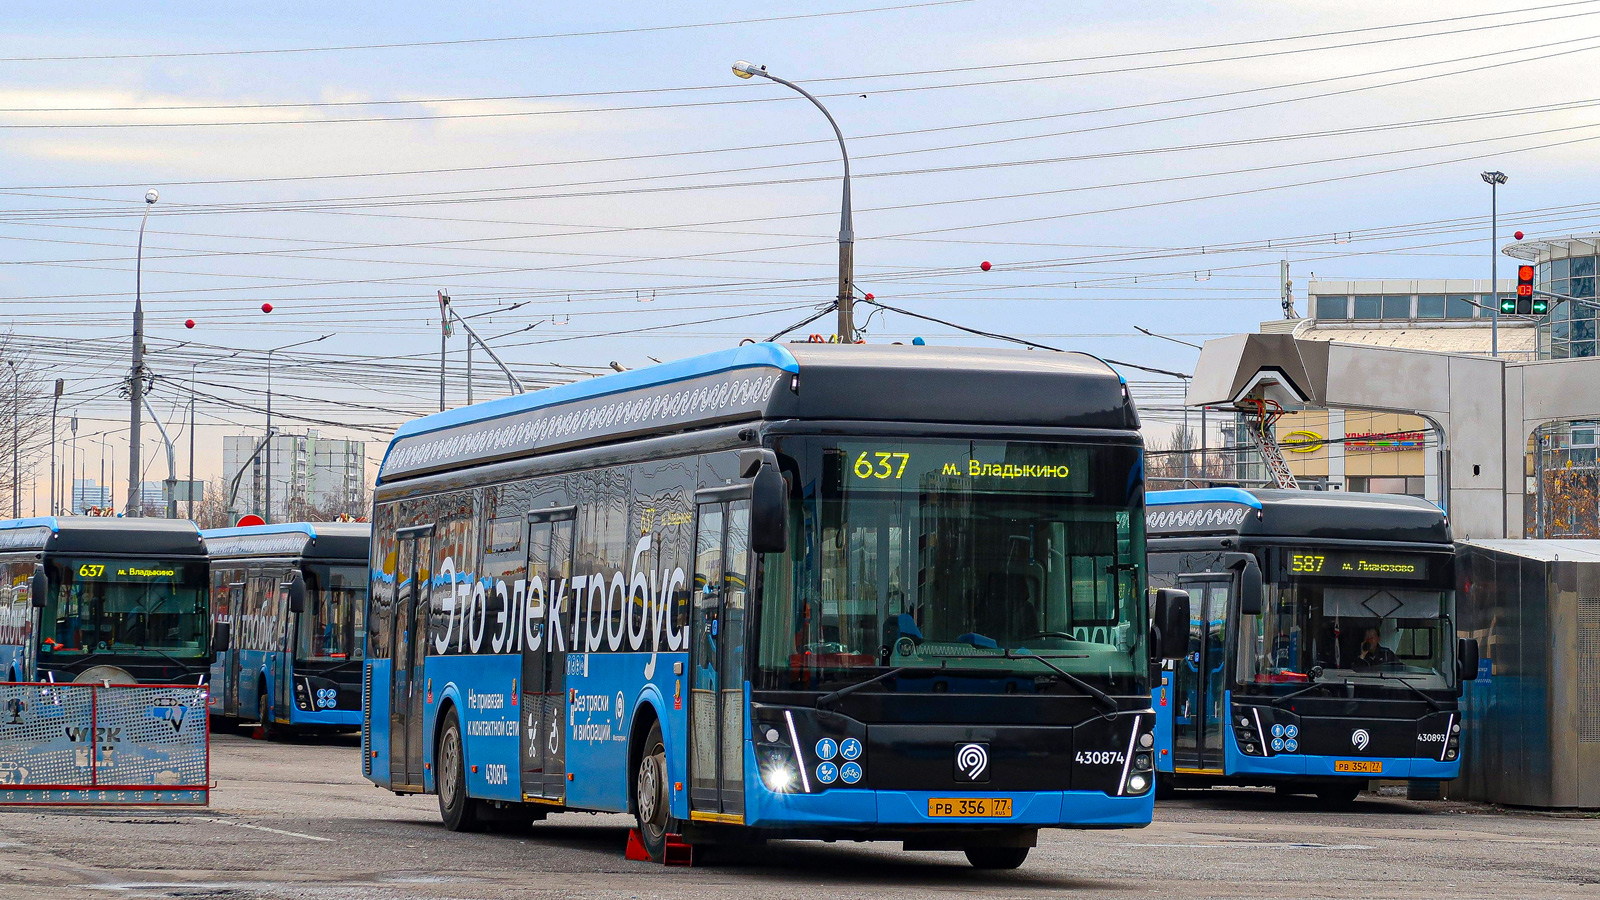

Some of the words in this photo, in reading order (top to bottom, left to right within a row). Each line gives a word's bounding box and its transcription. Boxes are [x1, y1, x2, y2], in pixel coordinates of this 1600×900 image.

[854, 450, 910, 479] 637
[942, 462, 961, 476] м.
[968, 459, 1070, 479] Владыкино
[79, 564, 105, 577] 637
[129, 567, 174, 577] Владыкино
[1292, 555, 1325, 572] 587
[1342, 563, 1353, 571] м.
[1357, 560, 1415, 573] Лианозово
[435, 556, 486, 655] Это
[491, 534, 689, 680] электробус.
[468, 688, 477, 709] Не
[477, 693, 504, 714] привязан
[573, 689, 586, 712] Без
[586, 694, 610, 717] тряски
[472, 716, 505, 737] контактной
[505, 721, 520, 737] сети
[573, 724, 578, 741] и
[578, 717, 611, 746] вибраций
[1417, 733, 1445, 742] 430893
[1074, 751, 1125, 765] 430874
[1338, 763, 1349, 771] РВ
[1352, 761, 1368, 771] 354
[1371, 761, 1381, 769] 77
[485, 763, 508, 785] 430874
[935, 803, 953, 815] РВ
[959, 800, 985, 815] 356
[993, 800, 1007, 811] 77
